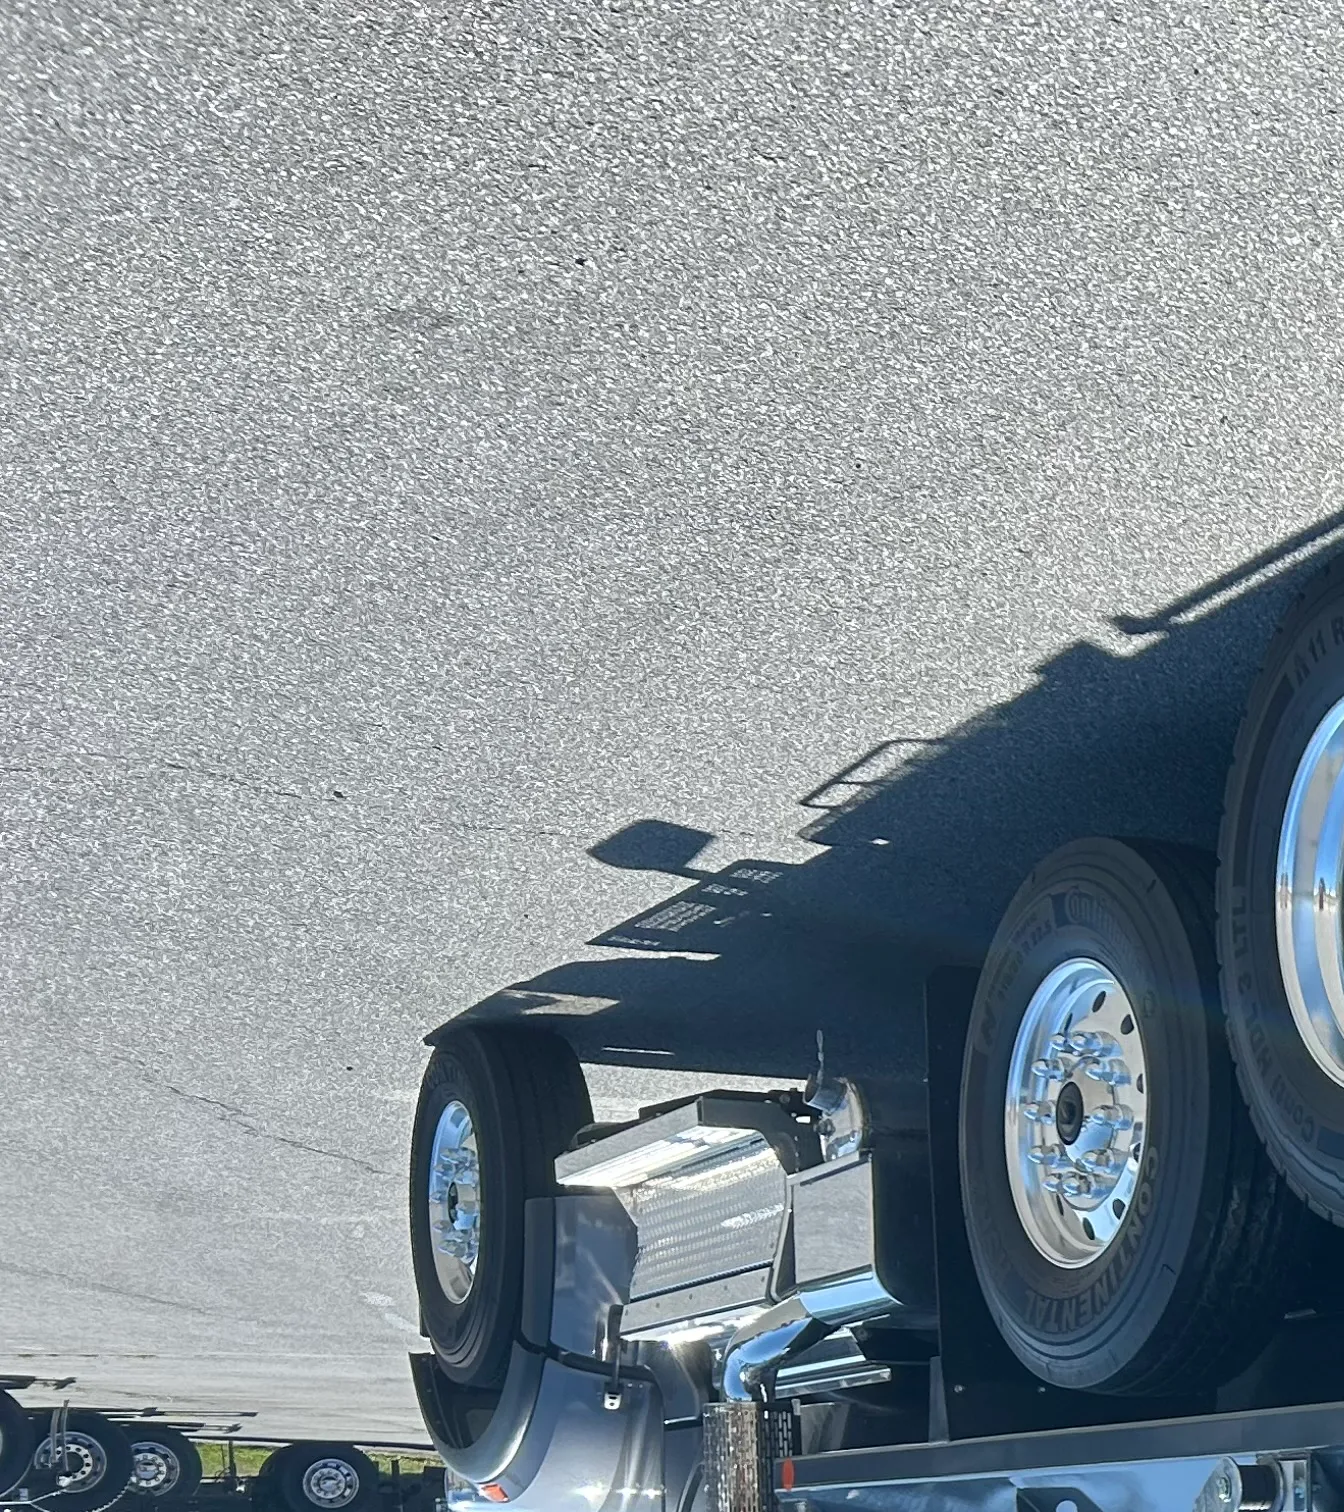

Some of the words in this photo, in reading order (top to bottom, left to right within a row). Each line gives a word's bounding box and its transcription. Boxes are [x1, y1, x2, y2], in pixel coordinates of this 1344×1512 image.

[1231, 895, 1249, 959] LTL
[1237, 970, 1252, 995] 3
[1270, 1074, 1317, 1145] Conti
[1022, 1144, 1159, 1334] CONTINENTAL
